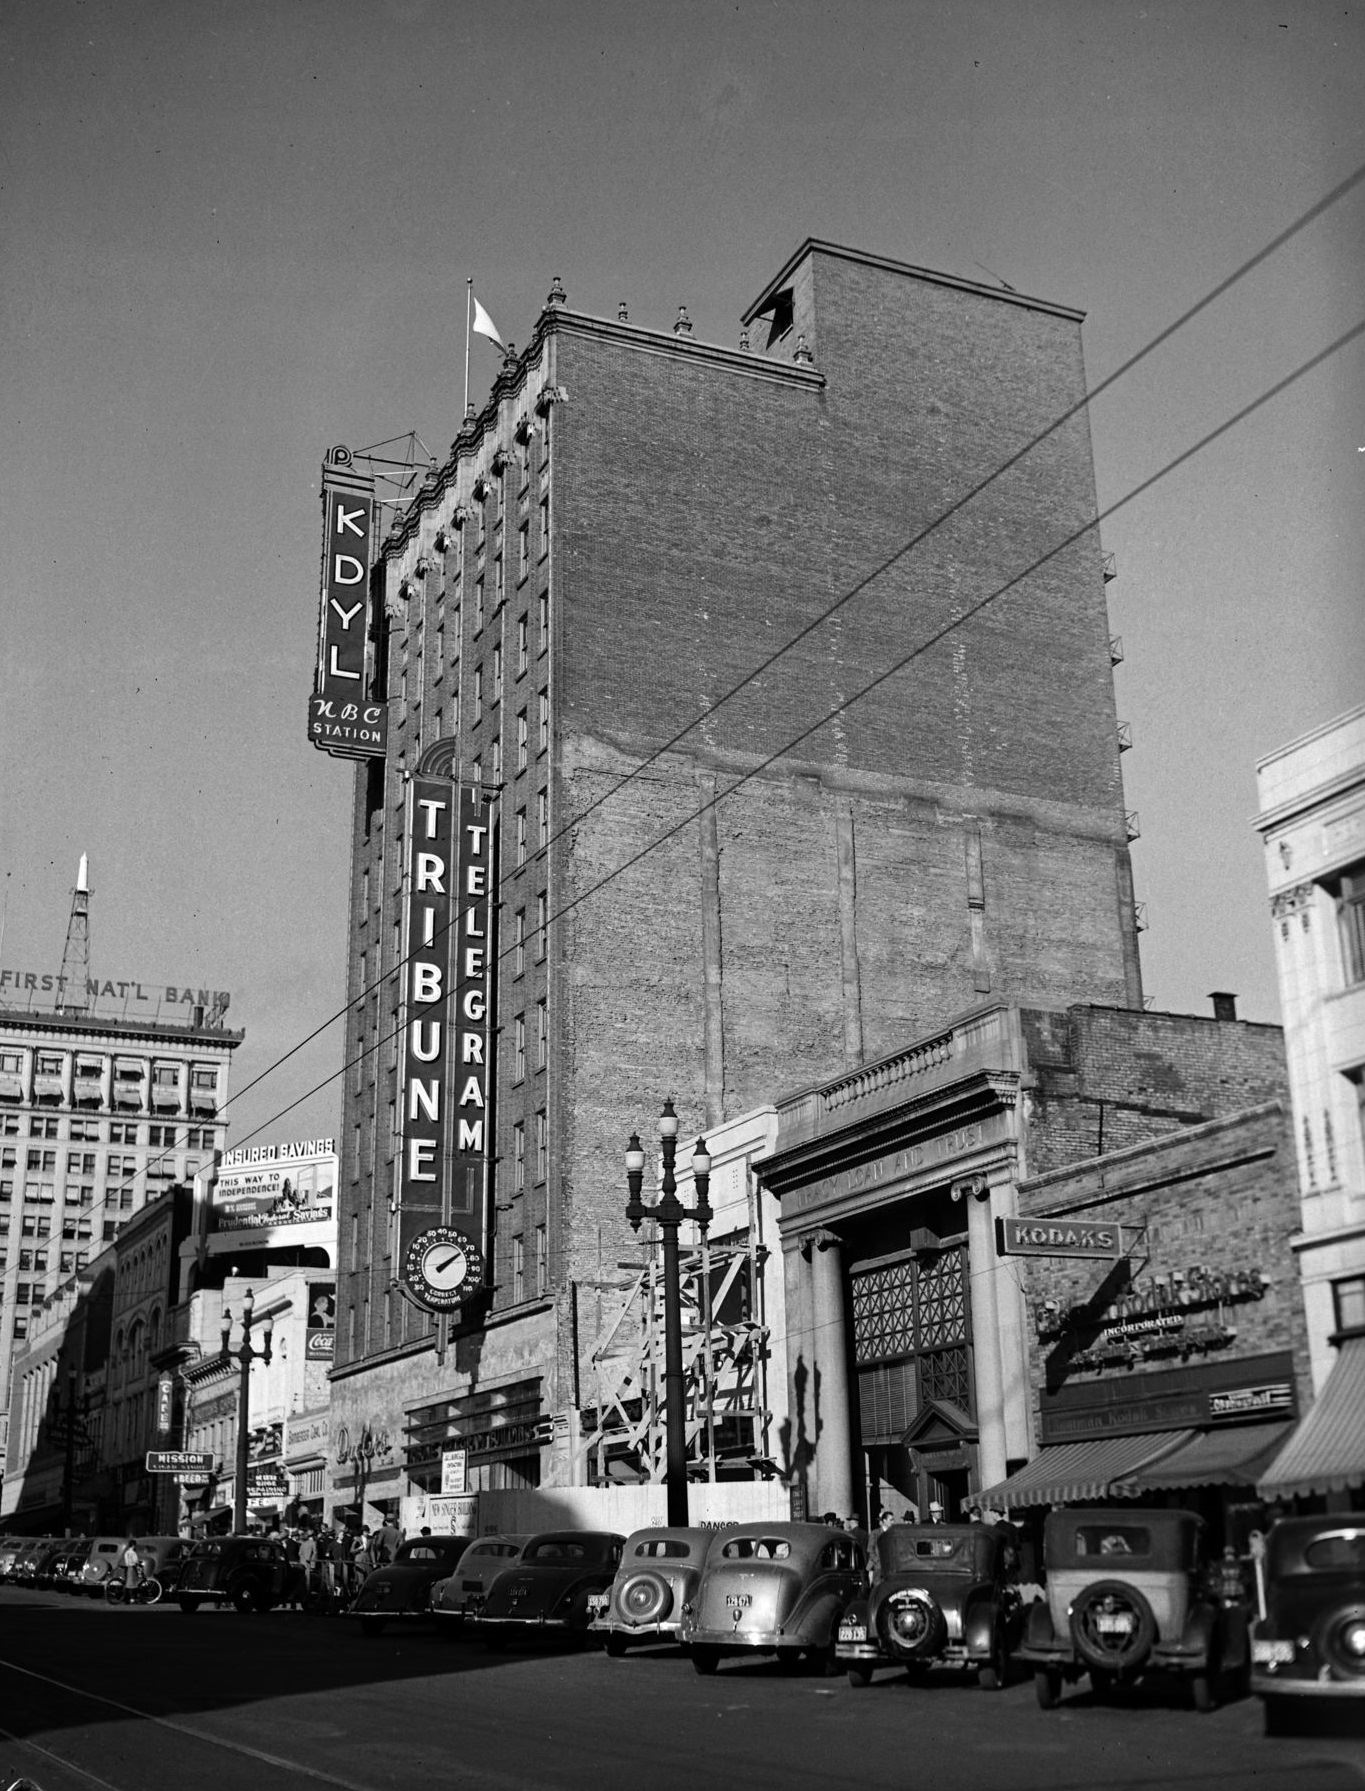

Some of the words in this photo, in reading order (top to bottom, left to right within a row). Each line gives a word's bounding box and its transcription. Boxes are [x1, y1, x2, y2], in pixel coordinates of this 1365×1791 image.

[328, 503, 367, 680] KDYL
[313, 699, 382, 725] NBC
[313, 722, 382, 743] STATION
[0, 970, 69, 992] FIRST
[86, 979, 148, 1001] NAT'L
[165, 986, 230, 1008] BANK
[409, 798, 447, 1184] TRIBUNE
[457, 823, 488, 1154] TELEGRAM
[221, 1145, 278, 1166] INSURED
[280, 1138, 335, 1158] SAVINGS
[795, 1176, 839, 1206] TRACY
[847, 1161, 883, 1188] LOAN
[895, 1146, 923, 1174] AND
[936, 1125, 984, 1158] TRUST
[219, 1183, 280, 1197] INDEPENDENCE!
[220, 1178, 239, 1187] THIS
[244, 1175, 264, 1185] WAY
[269, 1173, 280, 1181] TO
[293, 1208, 328, 1221] Savings
[1015, 1225, 1114, 1250] KODAKS
[1103, 1315, 1183, 1337] INCORPORATED
[160, 1384, 170, 1422] CAFE
[158, 1454, 204, 1464] MISSION
